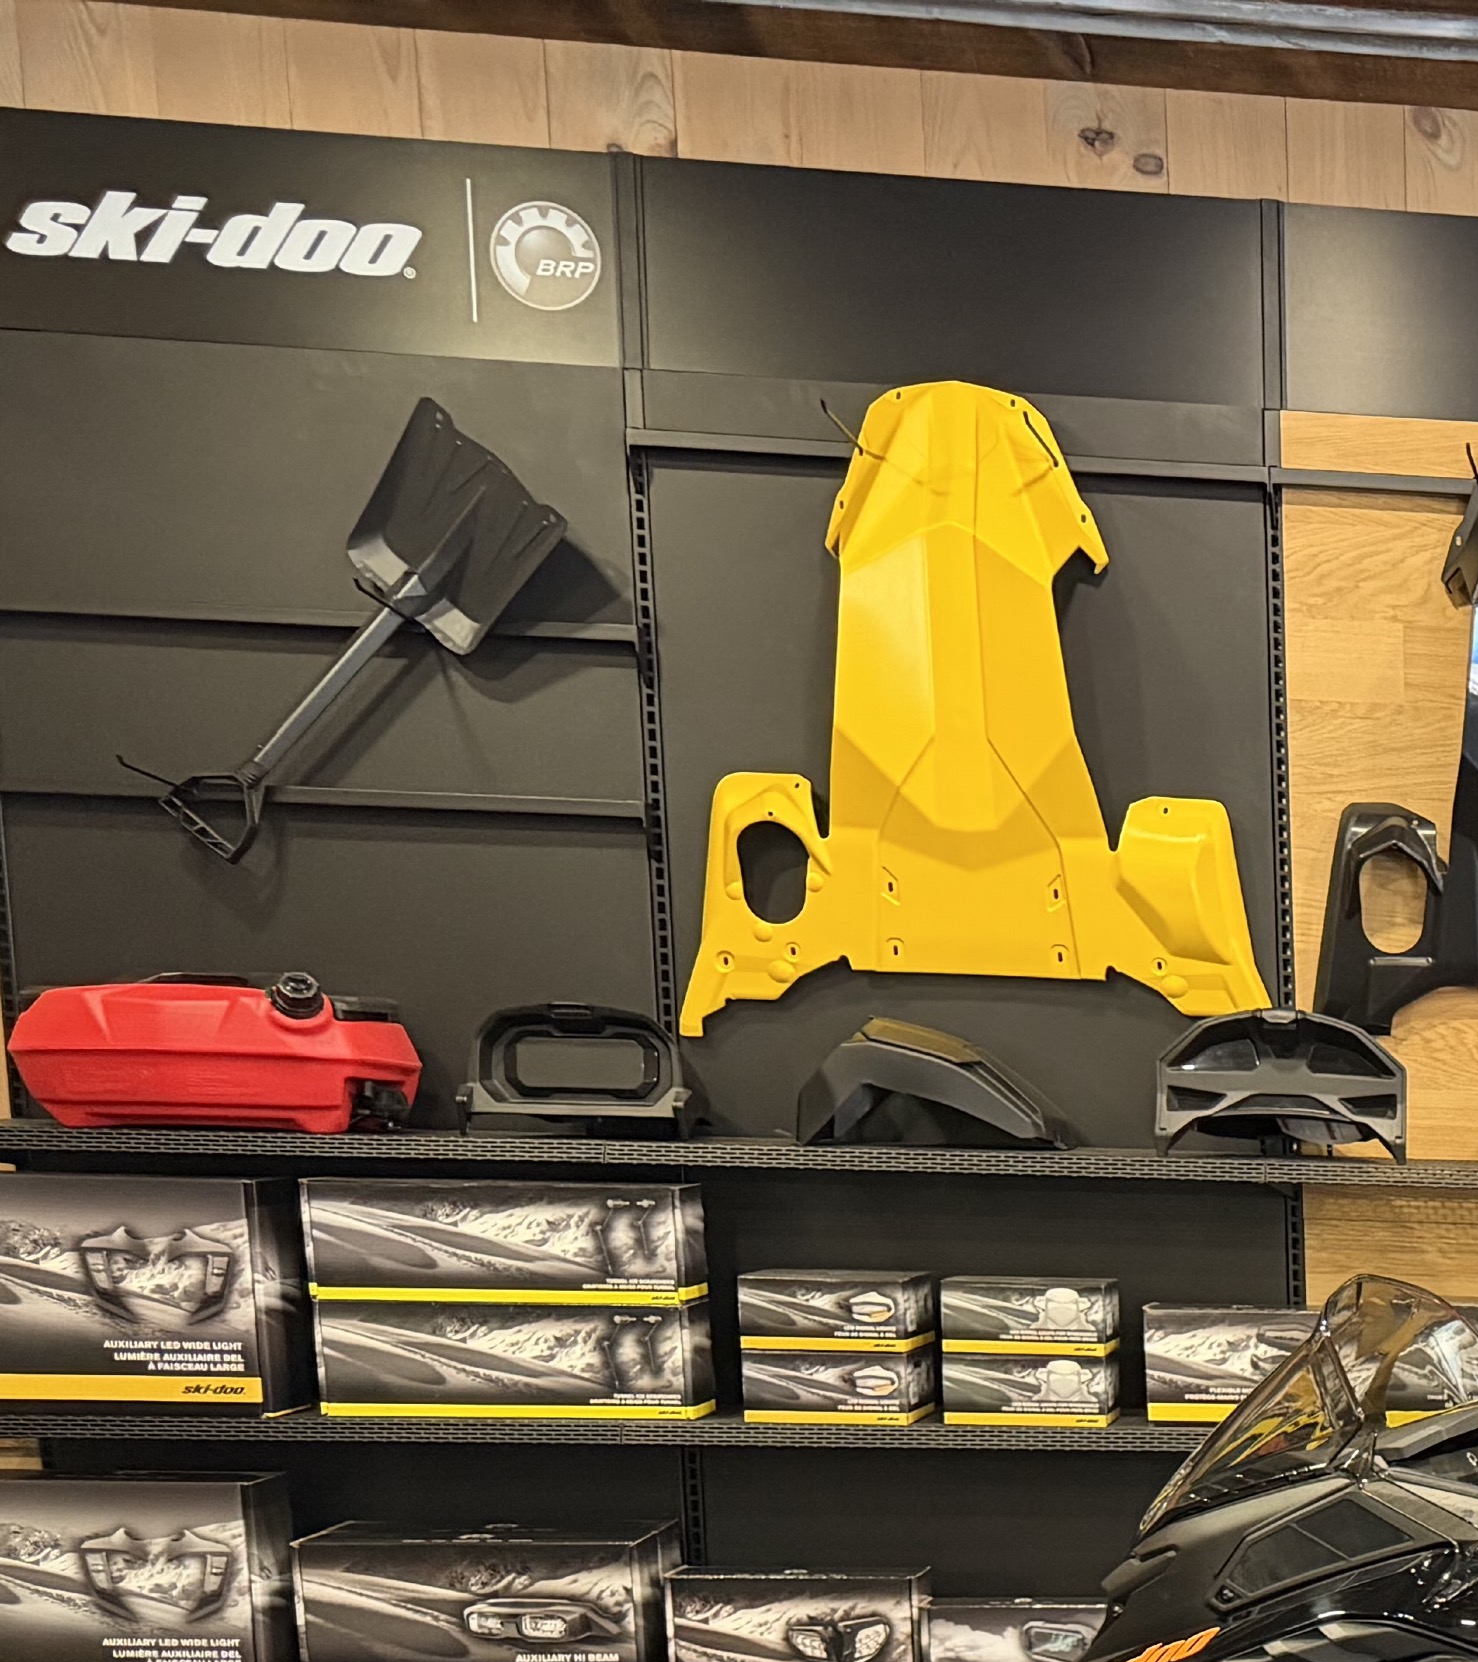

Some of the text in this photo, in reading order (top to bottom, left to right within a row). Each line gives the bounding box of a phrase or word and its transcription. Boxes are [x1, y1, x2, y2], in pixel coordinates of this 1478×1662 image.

[5, 191, 422, 277] ski-doo
[536, 259, 595, 280] BRP
[103, 1340, 242, 1350] AUXILIARY LED WIDE LIGHT
[114, 1351, 244, 1362] LUMIÈRE AUXILIAIRE DEL
[157, 1362, 208, 1371] FAISCEAU
[210, 1363, 245, 1372] LARGE
[182, 1384, 245, 1395] ski-doo
[102, 1638, 241, 1647] AUXILIARY LED WIDE LIGHT
[112, 1648, 242, 1659] LUMIÈRE AUXILIAIRE DEL
[515, 1653, 619, 1662] AUXILIARY HI BEAM
